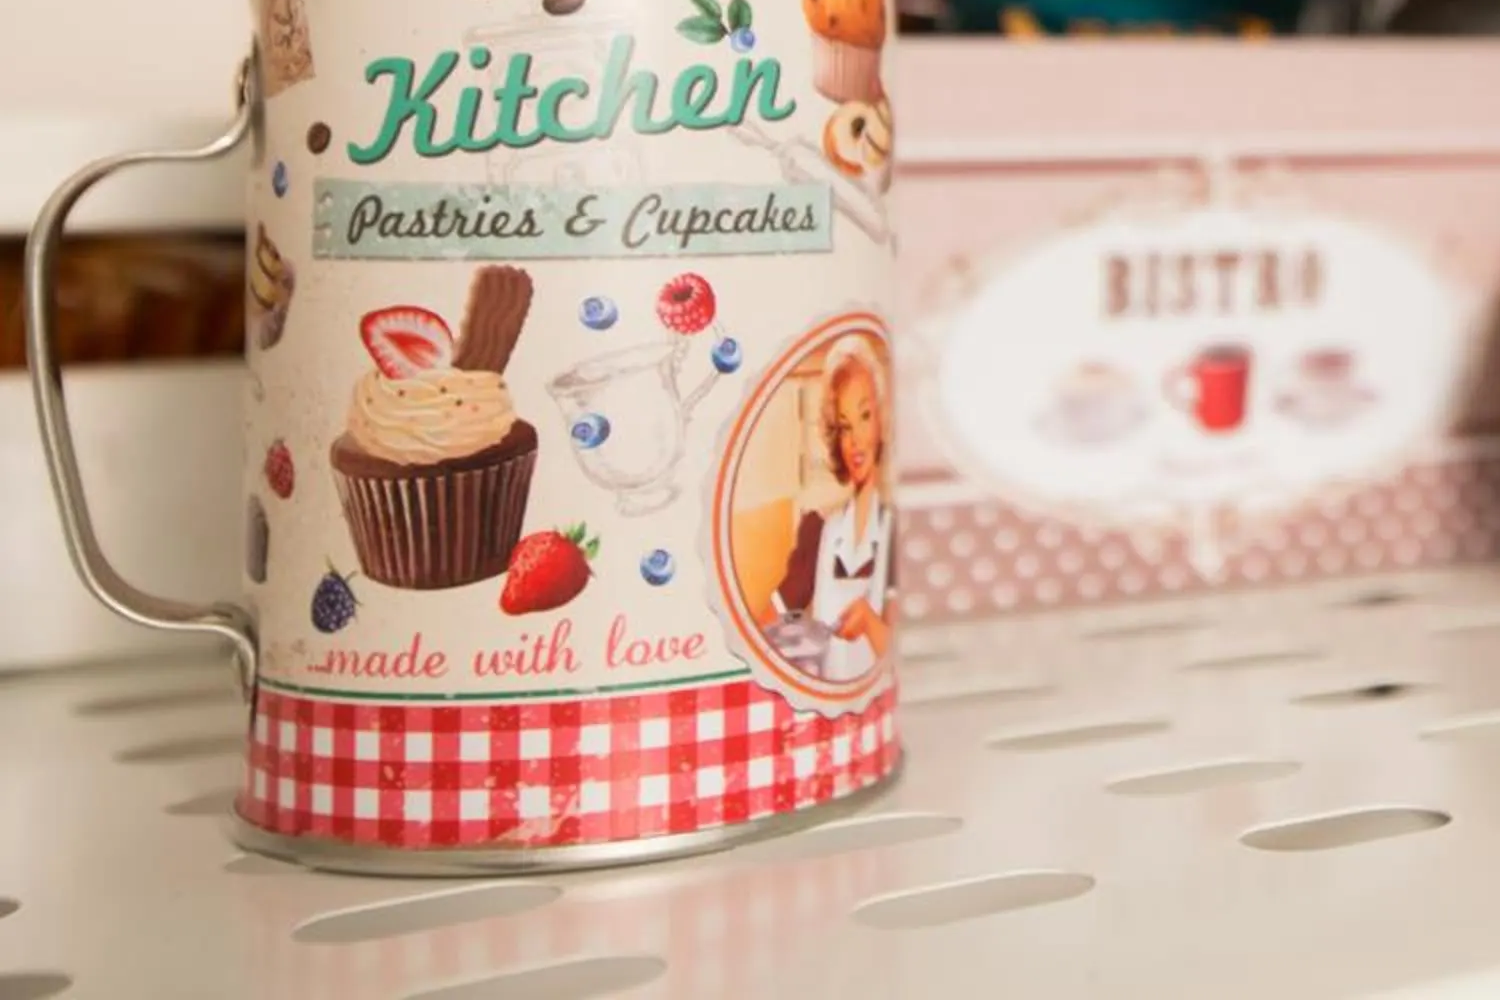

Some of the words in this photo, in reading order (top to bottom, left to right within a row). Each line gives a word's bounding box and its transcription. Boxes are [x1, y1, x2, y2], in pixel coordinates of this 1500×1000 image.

[348, 34, 797, 164] Kitchen
[347, 194, 543, 245] Pastries
[565, 194, 607, 237] &
[622, 193, 818, 249] Cupcakes
[1105, 249, 1325, 317] BISTRO
[473, 617, 579, 676] with
[605, 614, 706, 669] love
